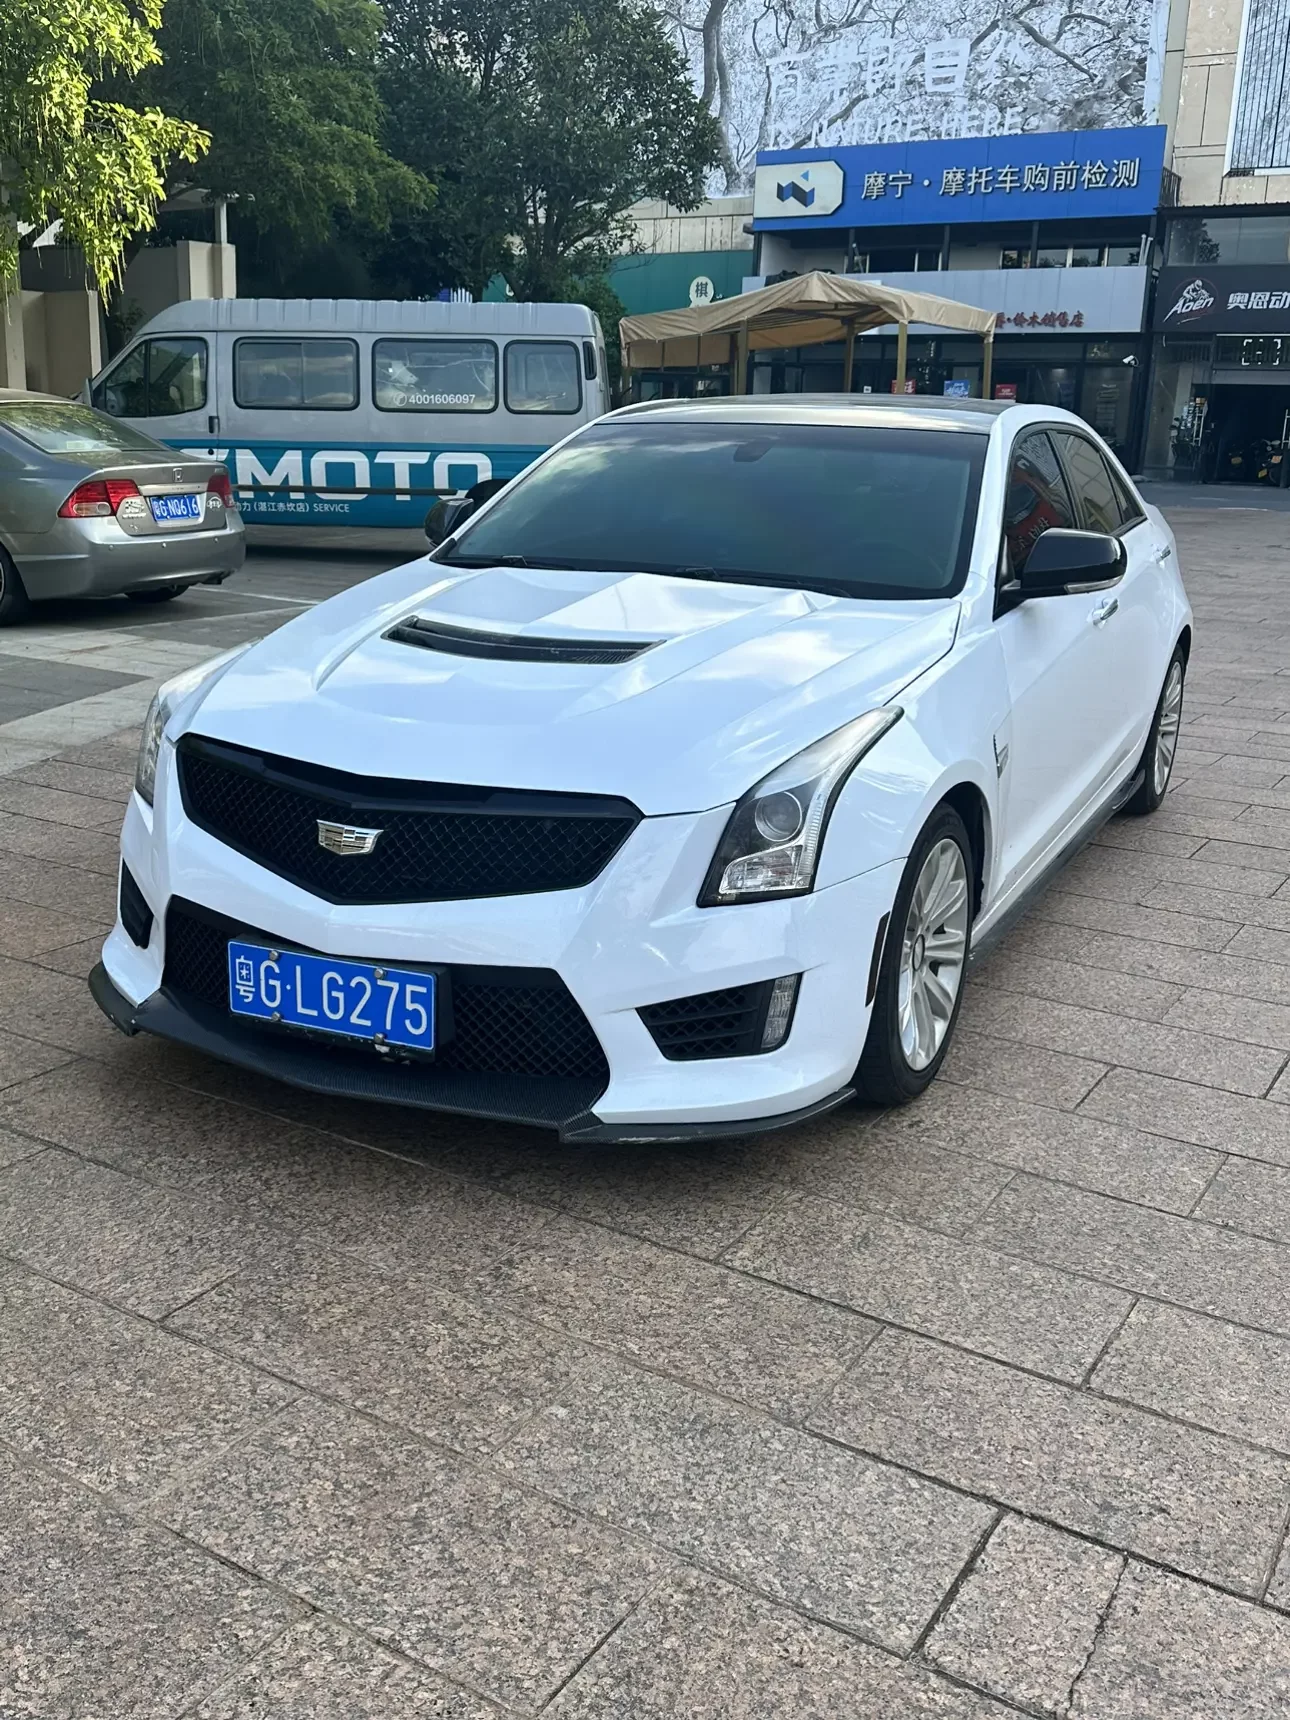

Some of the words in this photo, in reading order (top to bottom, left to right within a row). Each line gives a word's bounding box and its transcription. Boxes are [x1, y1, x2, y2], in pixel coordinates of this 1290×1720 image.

[810, 113, 926, 148] NATURE
[941, 106, 1024, 140] HERE
[861, 157, 1140, 201] 摩宁·摩托车购前检测
[695, 281, 709, 298] 棋
[408, 394, 476, 404] 4001606097
[180, 448, 493, 501] MOTO
[313, 503, 350, 513] SERVICE
[235, 955, 428, 1035] 粤G·LG275
